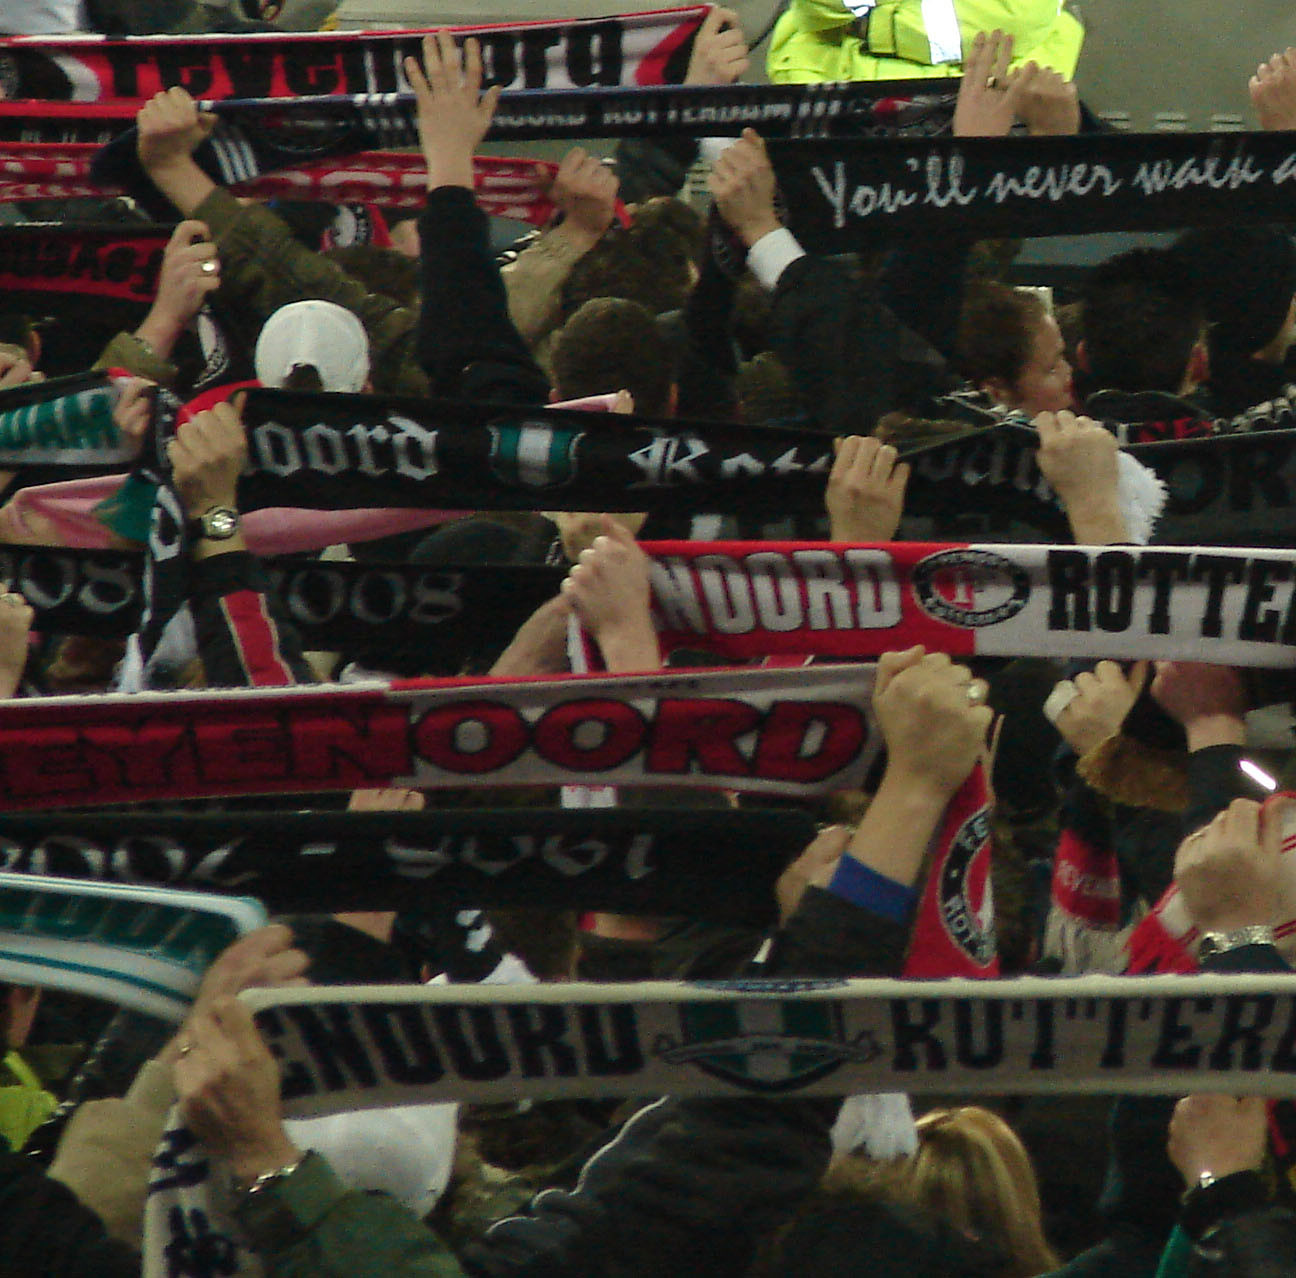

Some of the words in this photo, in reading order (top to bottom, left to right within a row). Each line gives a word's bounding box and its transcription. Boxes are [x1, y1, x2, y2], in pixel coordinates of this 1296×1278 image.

[810, 150, 976, 229] You'll
[985, 163, 1121, 208] never
[1133, 140, 1262, 196] walk
[648, 550, 904, 635] NOORD
